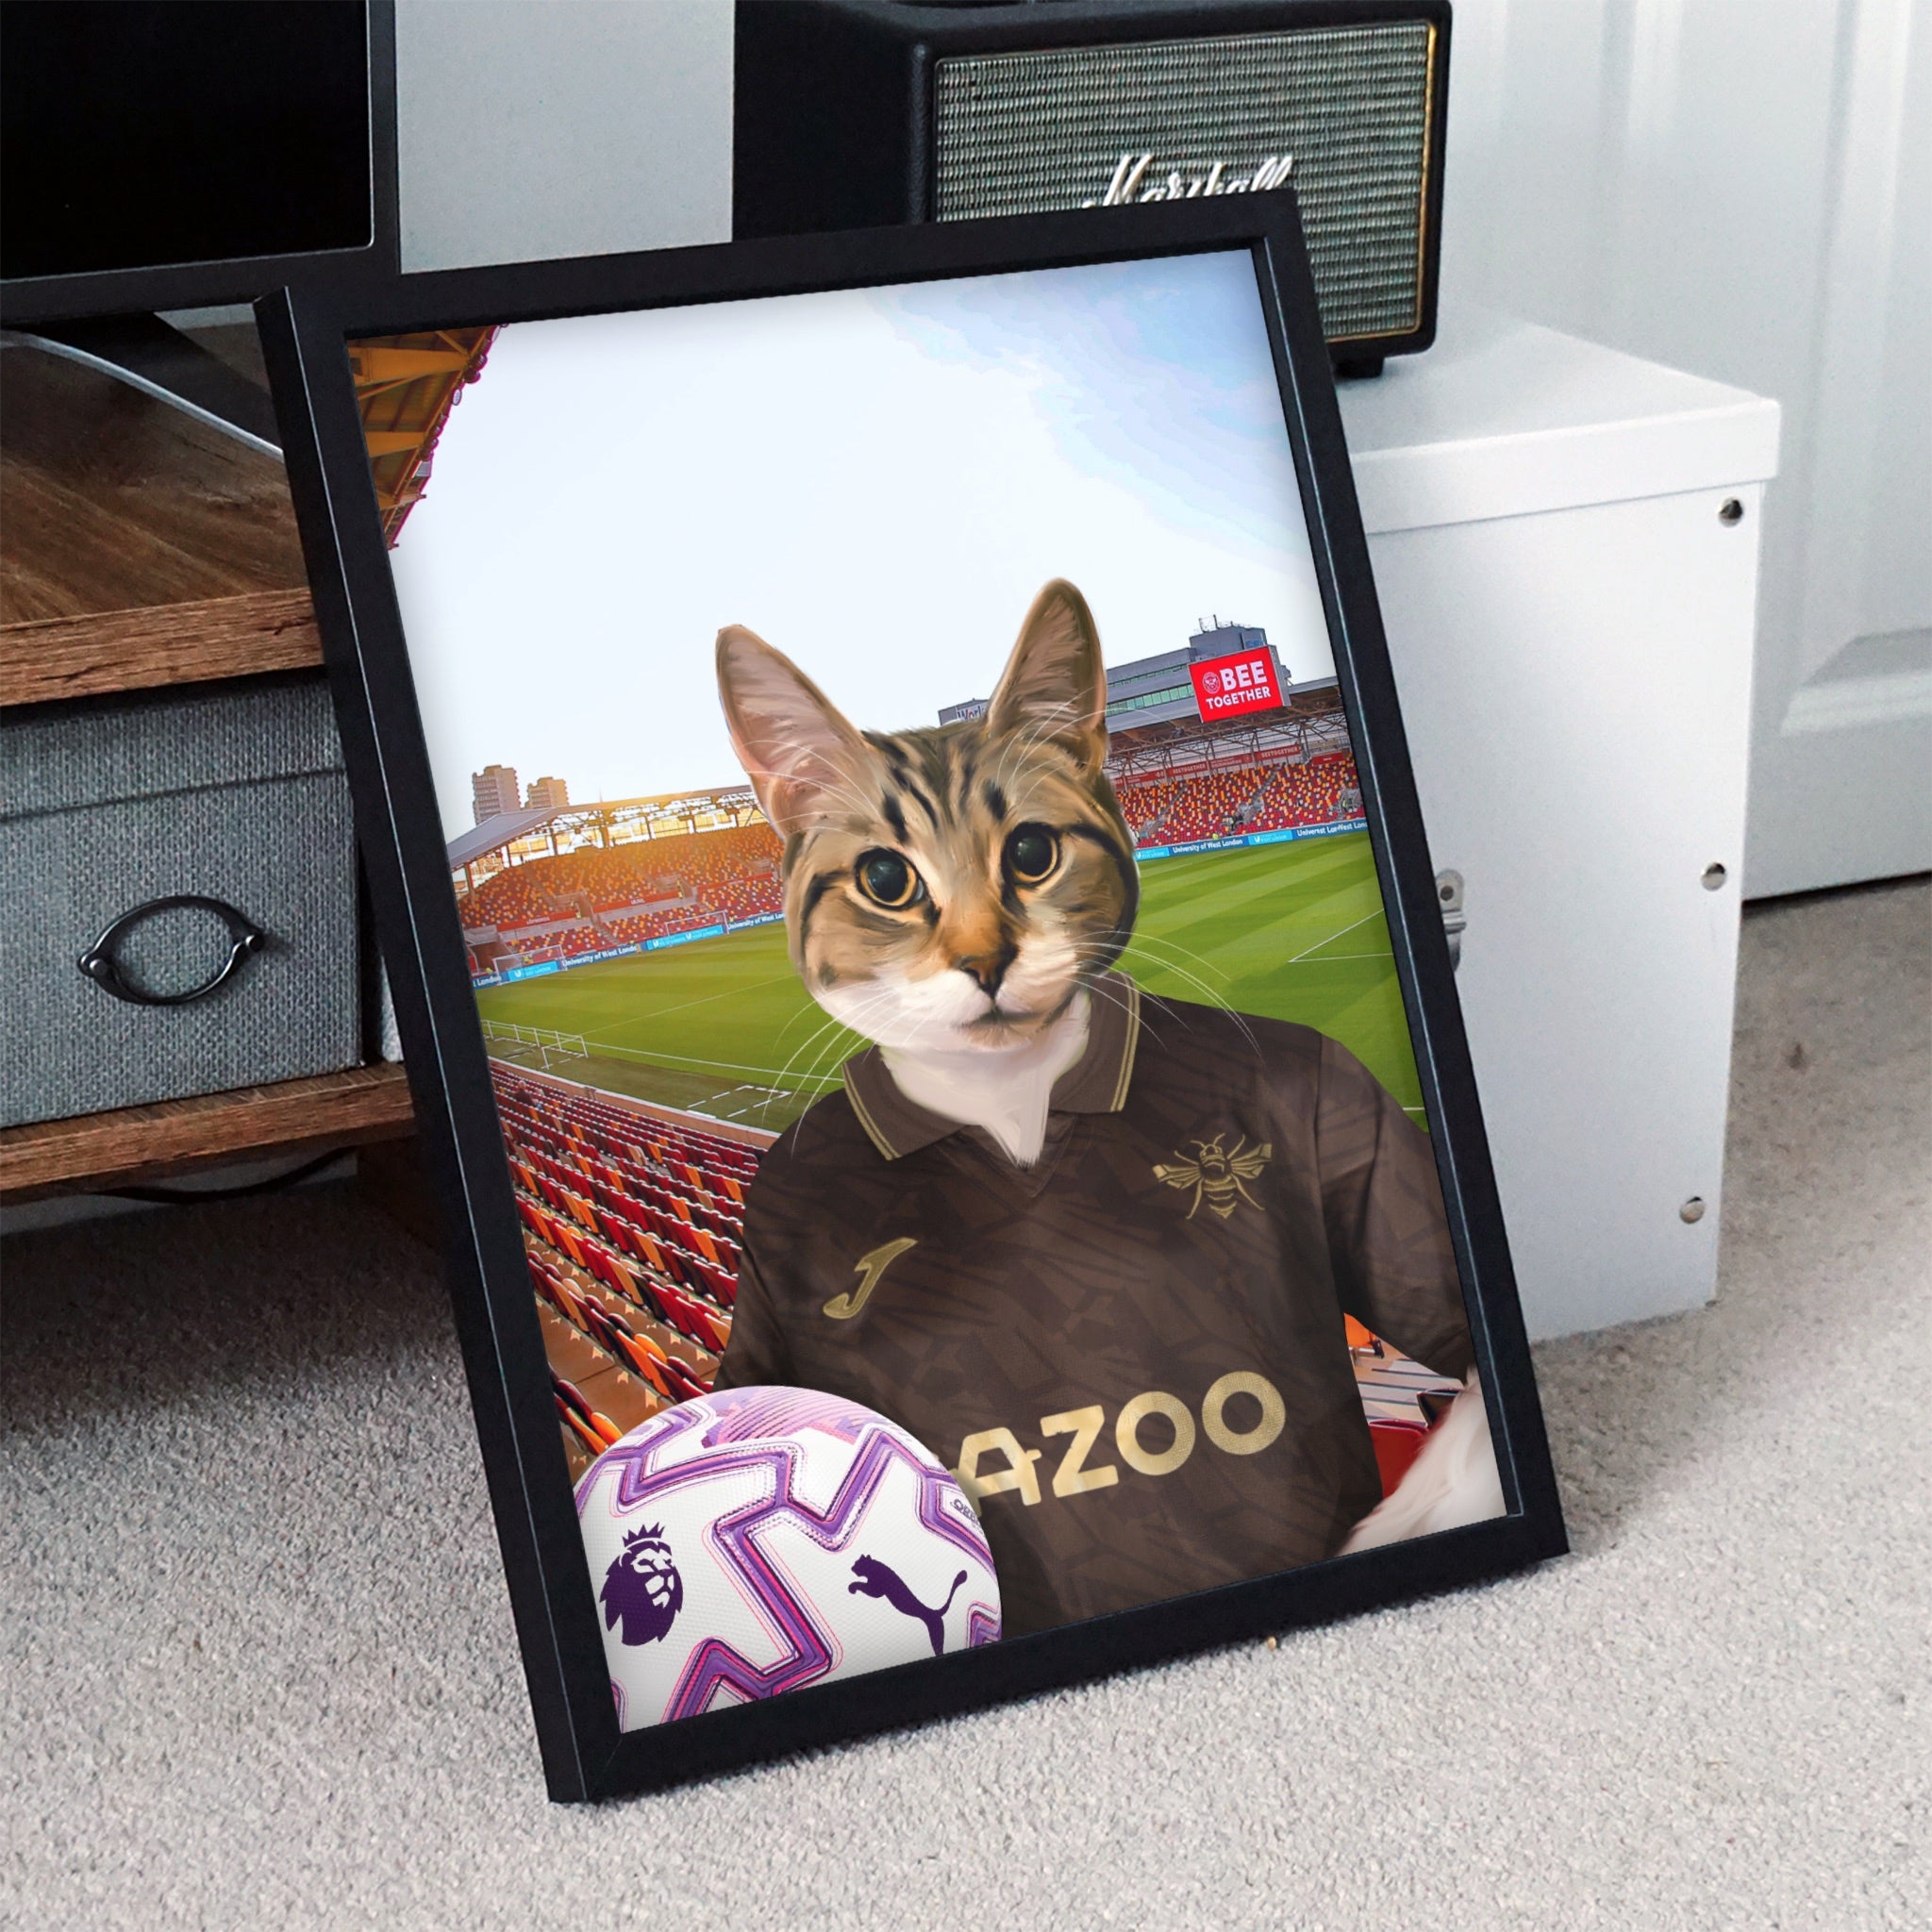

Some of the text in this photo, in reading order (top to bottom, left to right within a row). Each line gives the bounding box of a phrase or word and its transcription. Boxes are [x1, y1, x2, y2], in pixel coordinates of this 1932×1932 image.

[1220, 660, 1267, 691] BEE
[1206, 687, 1271, 709] TOGETHER
[958, 706, 986, 721] Worl
[1173, 843, 1200, 854] University
[727, 919, 754, 930] University
[562, 955, 593, 967] University
[593, 952, 602, 960] of
